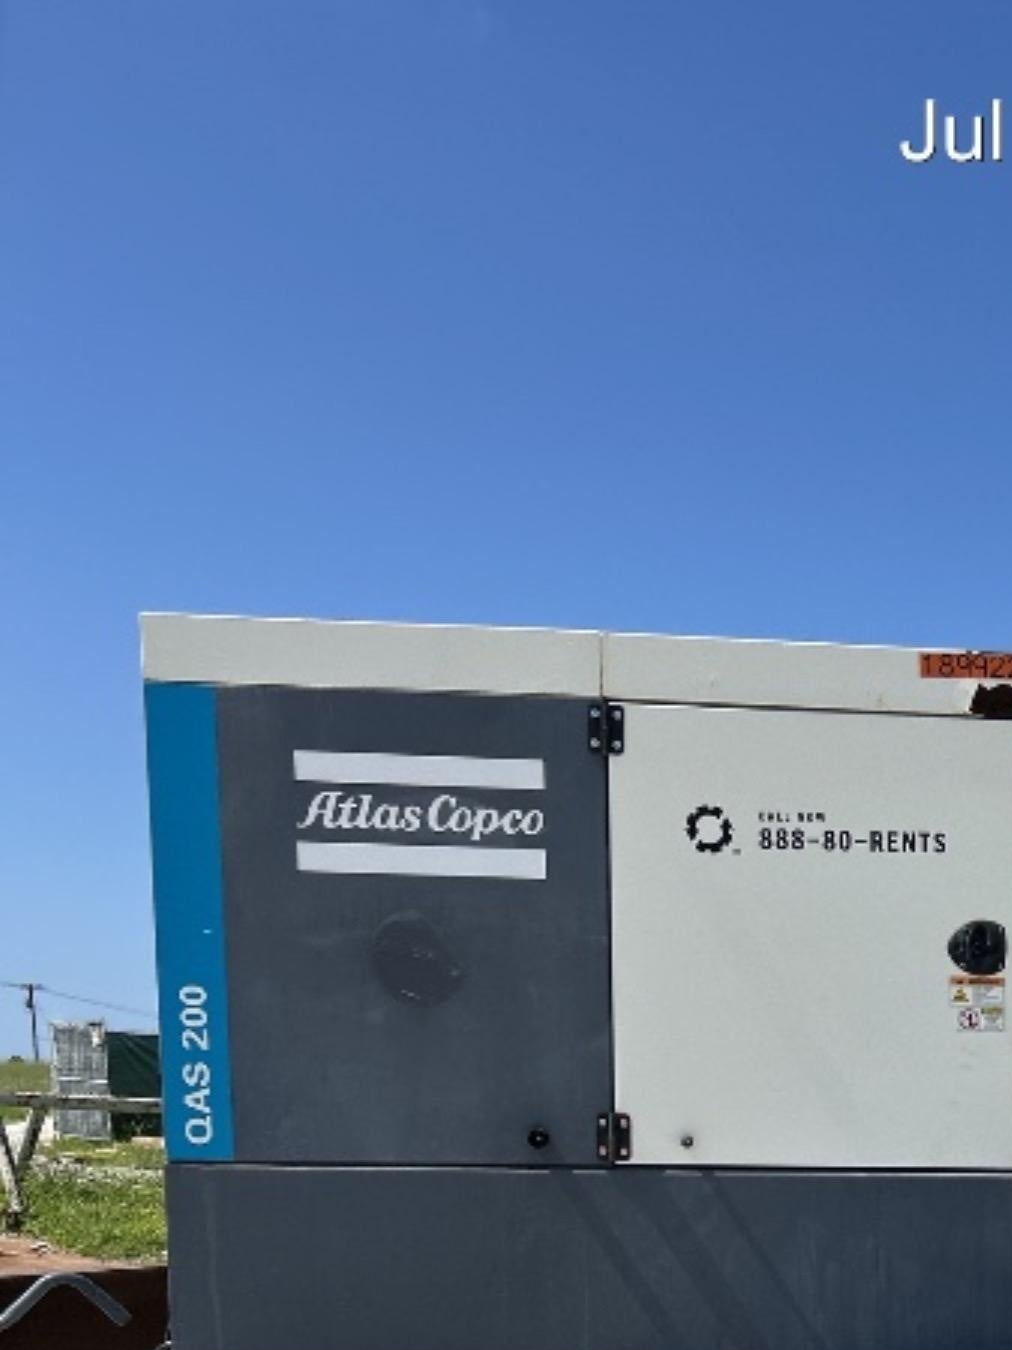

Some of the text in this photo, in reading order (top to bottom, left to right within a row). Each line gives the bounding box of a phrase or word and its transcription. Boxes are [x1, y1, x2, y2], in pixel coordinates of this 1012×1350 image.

[296, 791, 545, 841] Atlas Copco
[759, 827, 947, 853] 888-80-RENTS
[178, 984, 214, 1145] QAS 200
